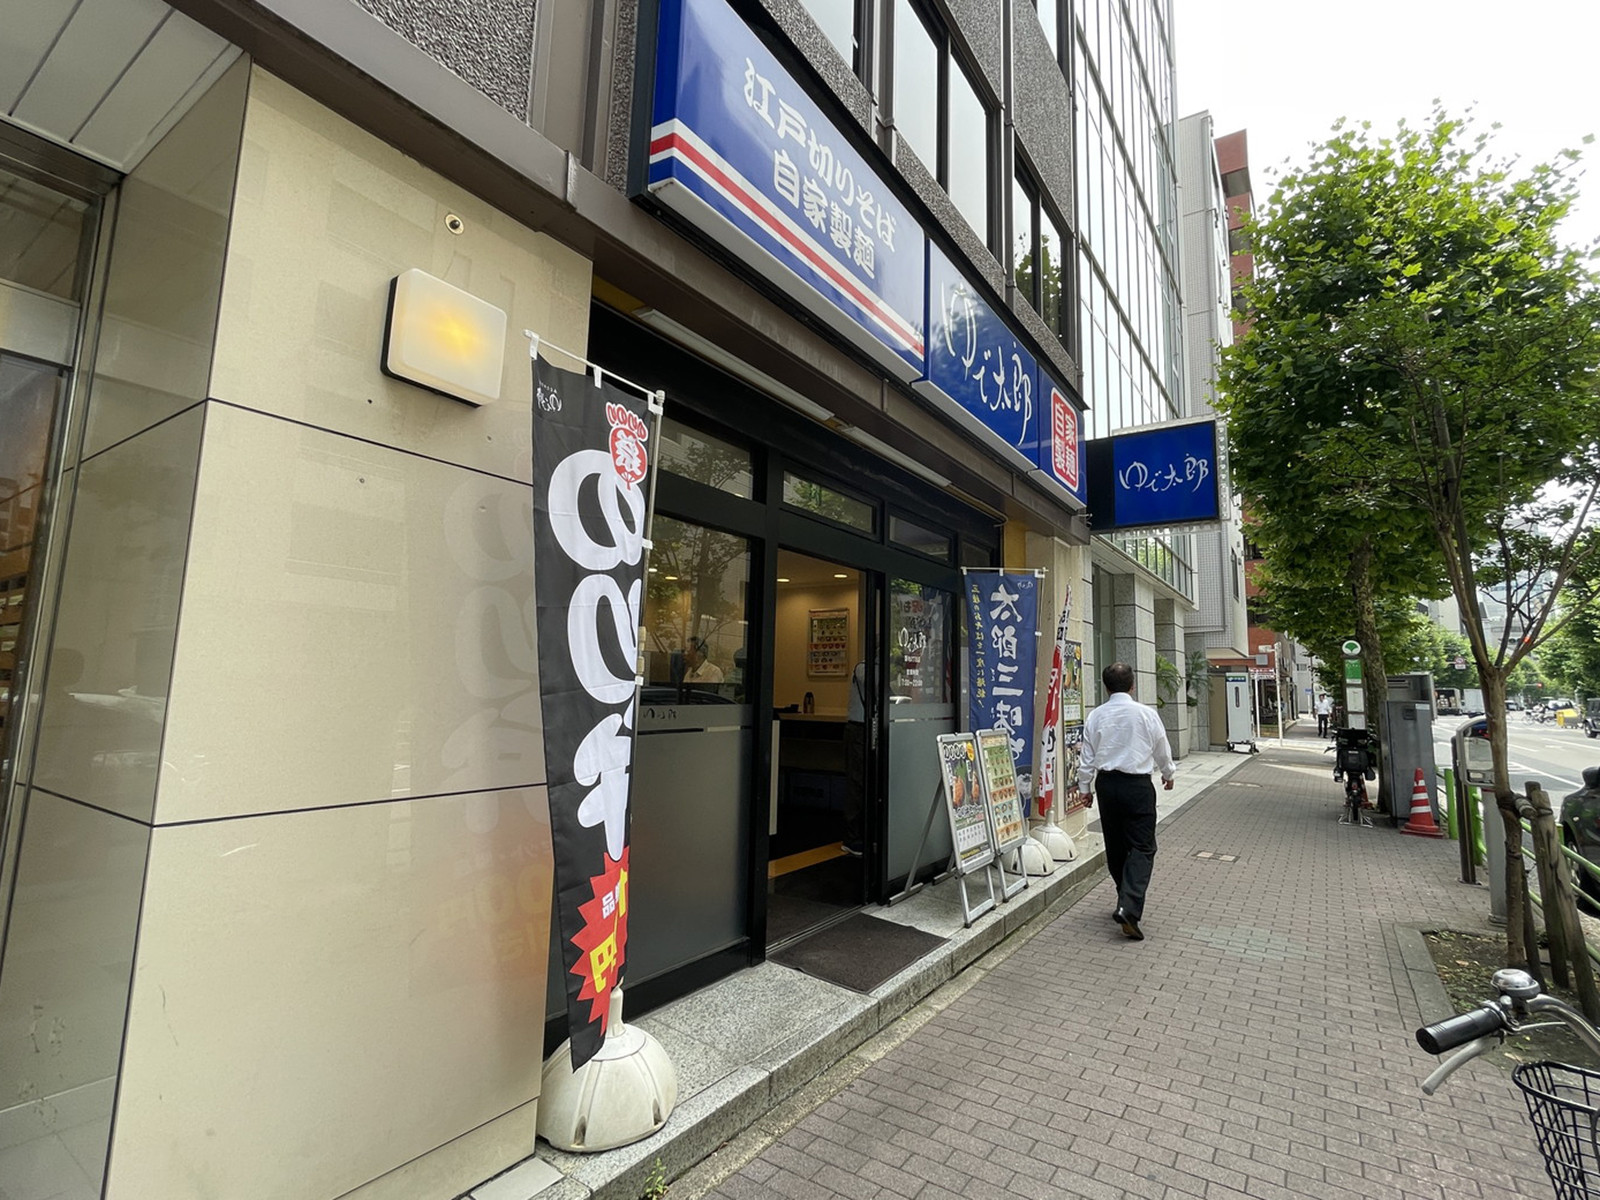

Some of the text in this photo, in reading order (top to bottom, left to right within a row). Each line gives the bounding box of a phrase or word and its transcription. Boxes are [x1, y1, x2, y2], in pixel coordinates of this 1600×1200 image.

[743, 57, 896, 252] 江戸切りそば
[773, 148, 875, 279] 自家製麺
[940, 281, 1032, 446] ゆで太郎
[1118, 453, 1209, 493] ゆで太郎
